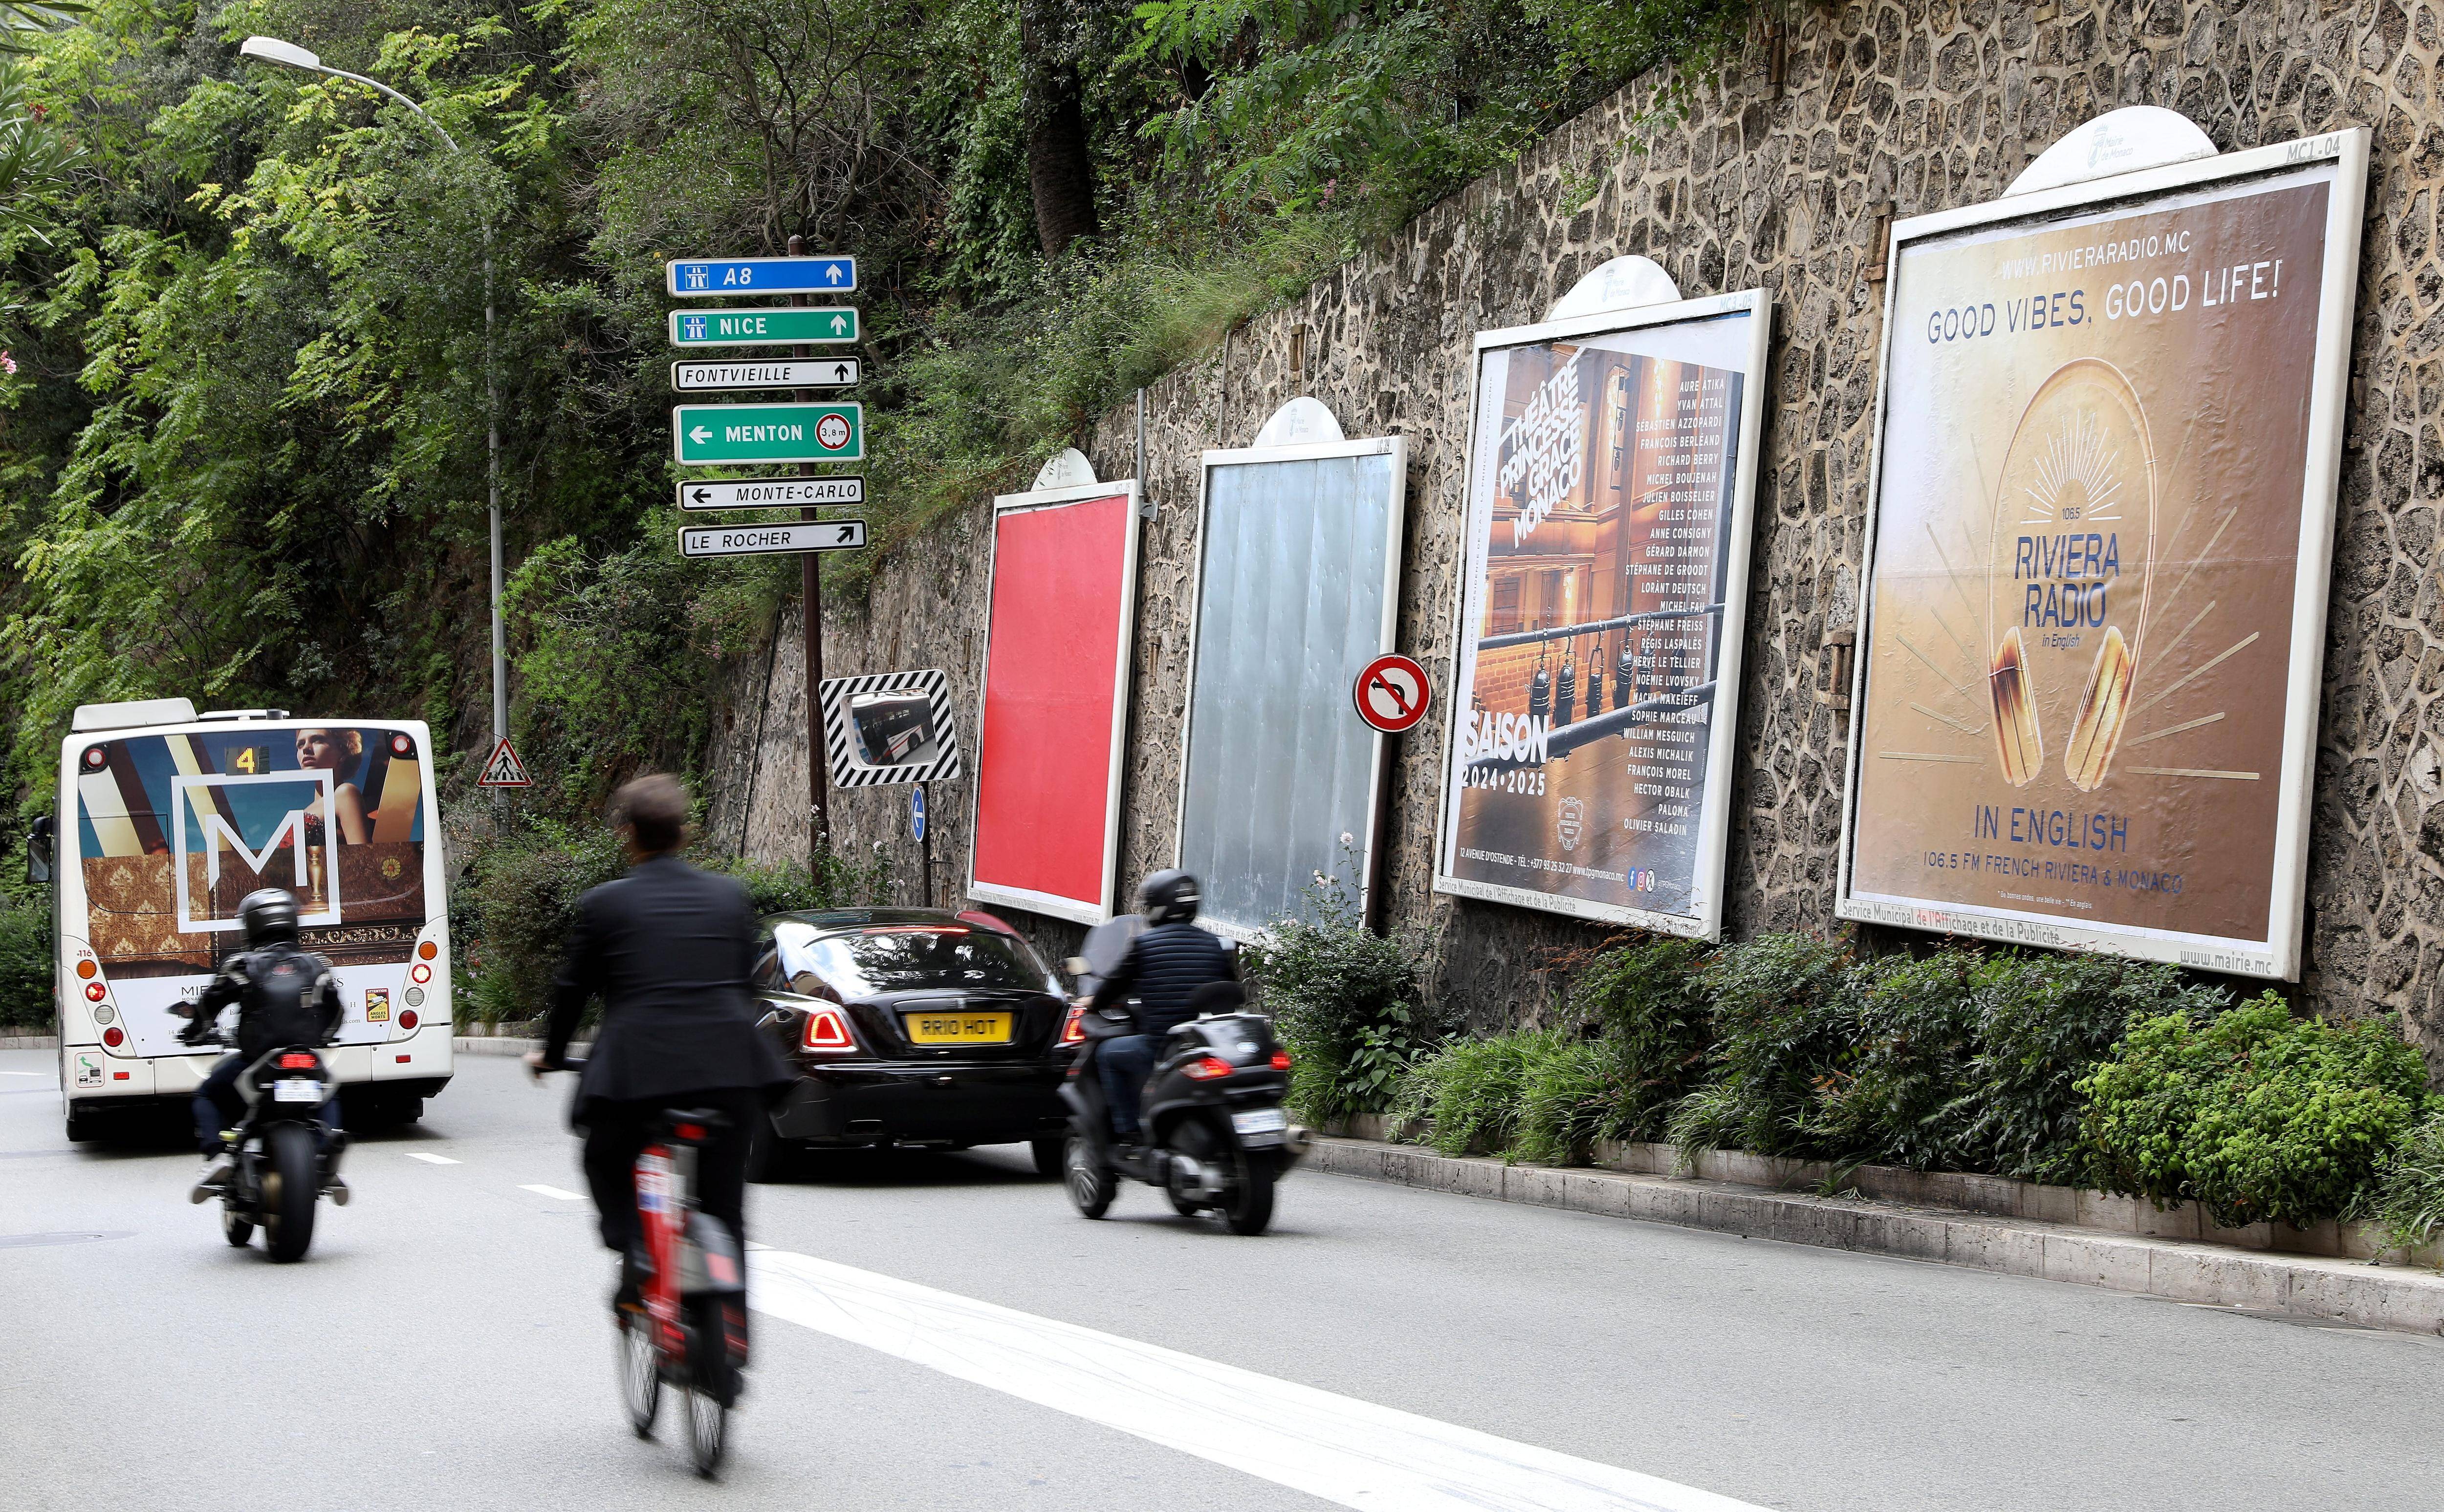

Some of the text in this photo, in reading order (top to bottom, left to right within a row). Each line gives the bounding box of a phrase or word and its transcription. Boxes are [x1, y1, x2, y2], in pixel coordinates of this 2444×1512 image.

[2001, 231, 2190, 280] WWW.RIVIERARADIO.MC
[723, 268, 752, 285] A8
[1928, 303, 1995, 344] GOOD
[2006, 289, 2092, 333] VIBES,
[2105, 275, 2190, 320] GOOD
[720, 318, 767, 335] NICE
[685, 367, 791, 382] FONTVIEILLE
[1680, 379, 1724, 392] AURE ATIKA
[1677, 397, 1723, 410] YVAN ATTAL
[1636, 416, 1721, 432] SÉBASTIEN AZZOPARDI
[725, 425, 802, 442] MENTON
[821, 428, 836, 437] 3,8
[1500, 389, 1580, 499] PRINCESSE
[1640, 433, 1720, 450] FRANÇOIS BERLÉAND
[1528, 422, 1581, 497] GRACE
[1658, 453, 1718, 466] RICHARD BERRY
[1647, 472, 1716, 485] MICHEL BOUJENAH
[736, 484, 856, 501] MONTE-CARLO
[1642, 491, 1715, 503] JULIEN BOISSELIER
[1513, 453, 1581, 549] MONACO
[1659, 509, 1713, 521] GILLES COHEN
[2062, 507, 2080, 519] 106.5
[692, 532, 790, 549] LE ROCHER
[1650, 528, 1711, 539] ANNE CONSIGNY
[1646, 544, 1709, 557] GÉRARD DARMON
[2014, 533, 2120, 579] RIVIERA
[1625, 562, 1708, 576] STÉPHANE DE GROODT
[1672, 583, 1706, 594] DEUTSCH
[1660, 601, 1704, 613] MICHEL FAU
[2024, 582, 2106, 627] RADIO
[1677, 620, 1703, 631] FREISS
[1641, 636, 1702, 649] RÉGIS LASPALÈS
[2042, 634, 2079, 650] in English
[1633, 654, 1700, 669] HERVÉ LE TELLIER
[1665, 675, 1699, 687] LVOVSKY
[1633, 692, 1657, 704] MACHA
[1632, 710, 1696, 724] SOPHIE MARCEAU
[1464, 709, 1549, 763] SAISON
[1623, 728, 1695, 743] WILLIAM MESGUICH
[237, 747, 255, 774] 4
[1629, 746, 1693, 762] ALEXIS MICHALIK
[1627, 764, 1691, 780] FRANÇOIS MOREL
[1634, 782, 1689, 799] HECTOR OBALK
[1658, 803, 1688, 817] PALOMA
[1624, 818, 1686, 836] OLIVIER SALADIN
[1974, 804, 1998, 840] IN
[1460, 847, 1465, 857] 12
[1465, 848, 1485, 861] AVENUE
[1485, 851, 1513, 865] D'OSTENDE
[1530, 858, 1542, 869] +377
[1543, 860, 1549, 870] 93
[1551, 861, 1557, 871] 25
[1558, 862, 1564, 872] 32
[1566, 863, 1572, 873] 27
[1573, 865, 1624, 882] www.tpgmonaco.mc
[1923, 850, 2183, 894] 106.5 FM FRENCH RIVIERA & MONACO
[1438, 877, 1576, 913] Service Municipal de l'Affichage et de la Publicité
[1842, 898, 2060, 945] Service Municipal de l'Affichage et de la Publicité
[2181, 950, 2271, 975] www.mairie.mc
[964, 1019, 997, 1035] HOT
